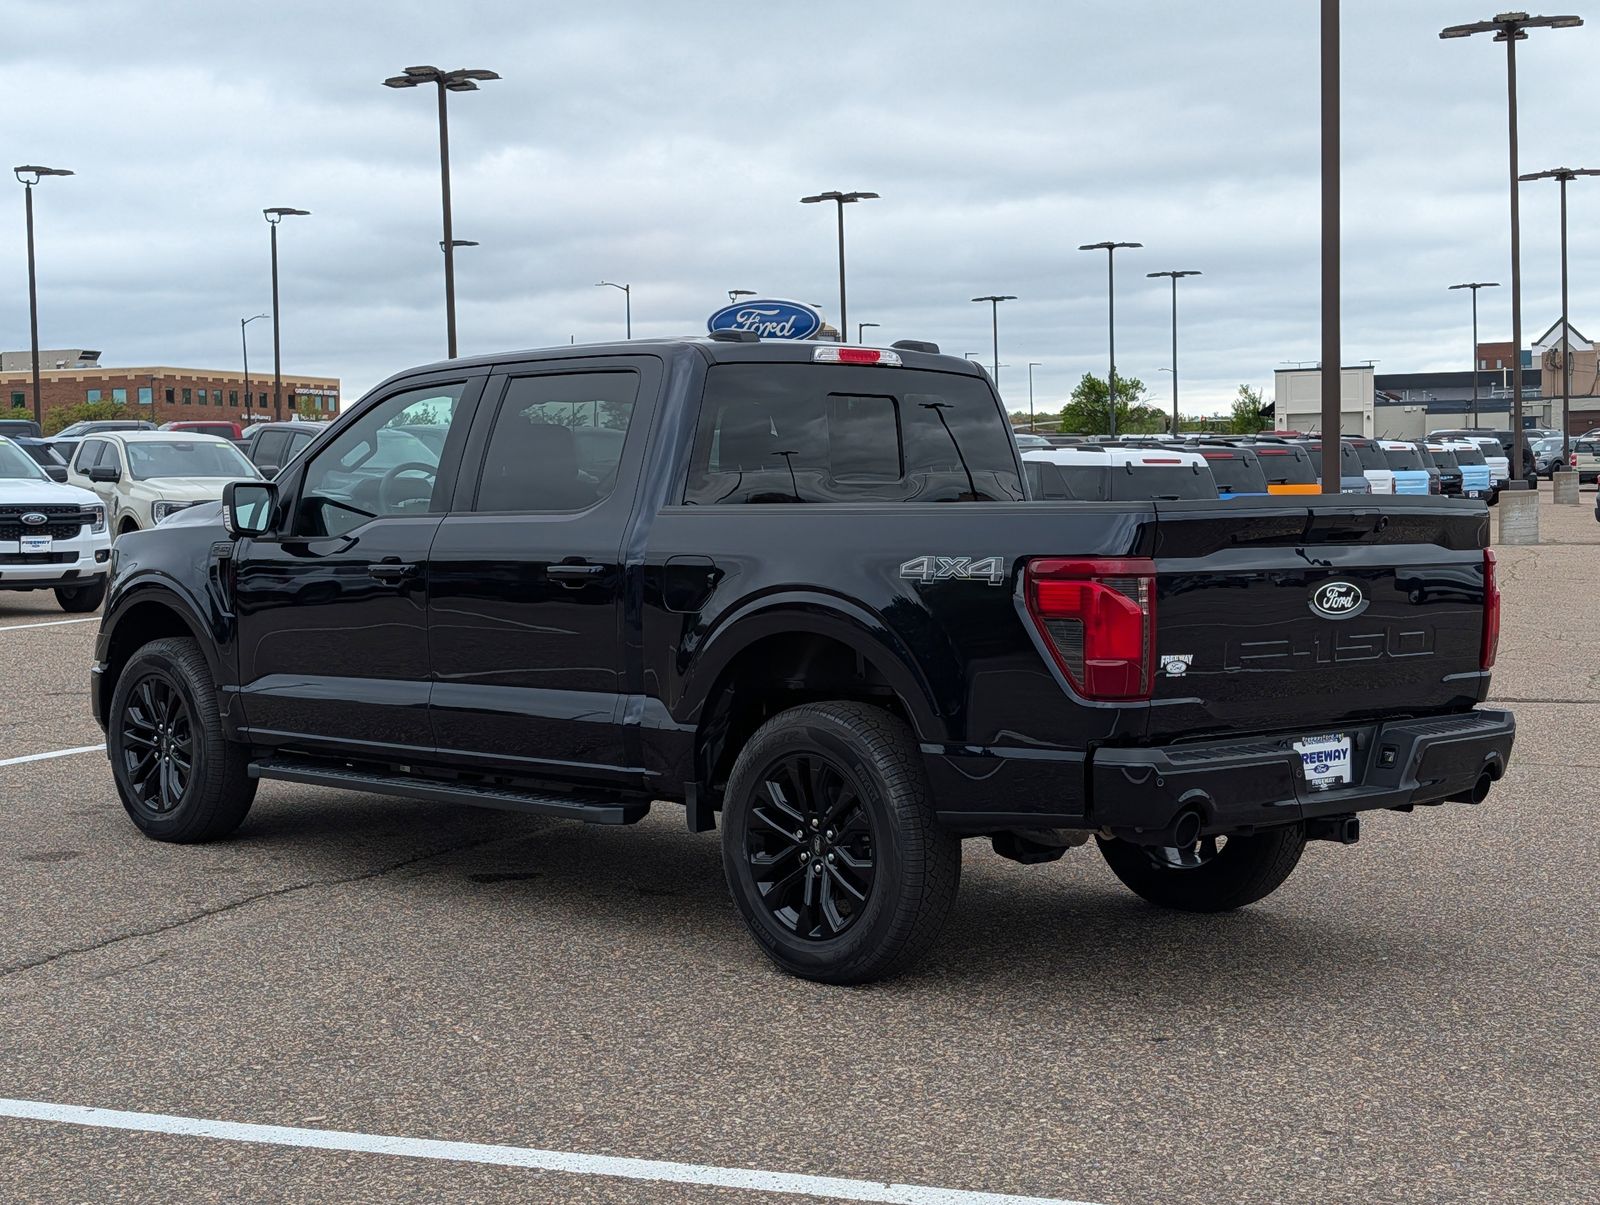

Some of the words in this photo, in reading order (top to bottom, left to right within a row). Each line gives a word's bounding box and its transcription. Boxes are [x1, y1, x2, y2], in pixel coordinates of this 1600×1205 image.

[733, 309, 797, 337] Ford
[1322, 586, 1355, 609] Ford
[1224, 624, 1436, 670] F-150
[1300, 747, 1349, 764] REEWAY
